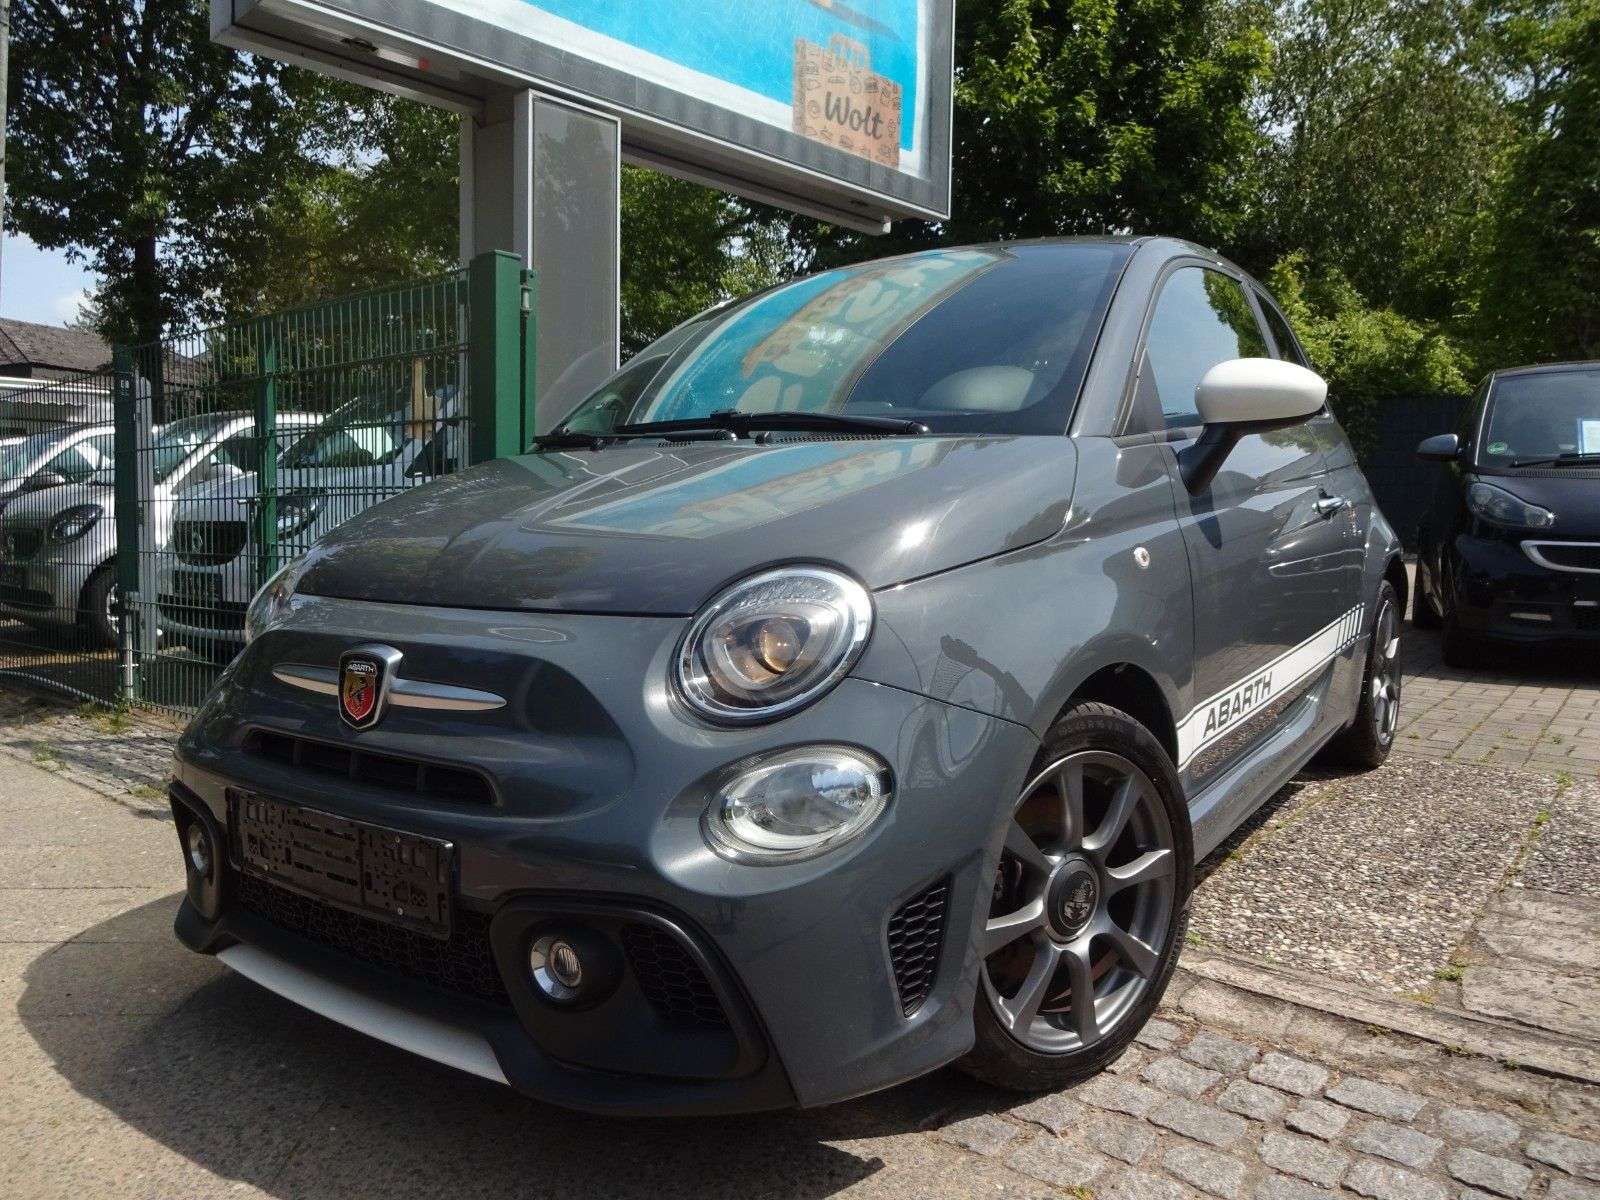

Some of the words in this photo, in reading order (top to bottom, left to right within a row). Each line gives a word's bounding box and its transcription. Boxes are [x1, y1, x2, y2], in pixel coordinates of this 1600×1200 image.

[824, 91, 883, 140] Wolt
[347, 663, 375, 673] ABARTH
[1203, 672, 1273, 738] ABARTH
